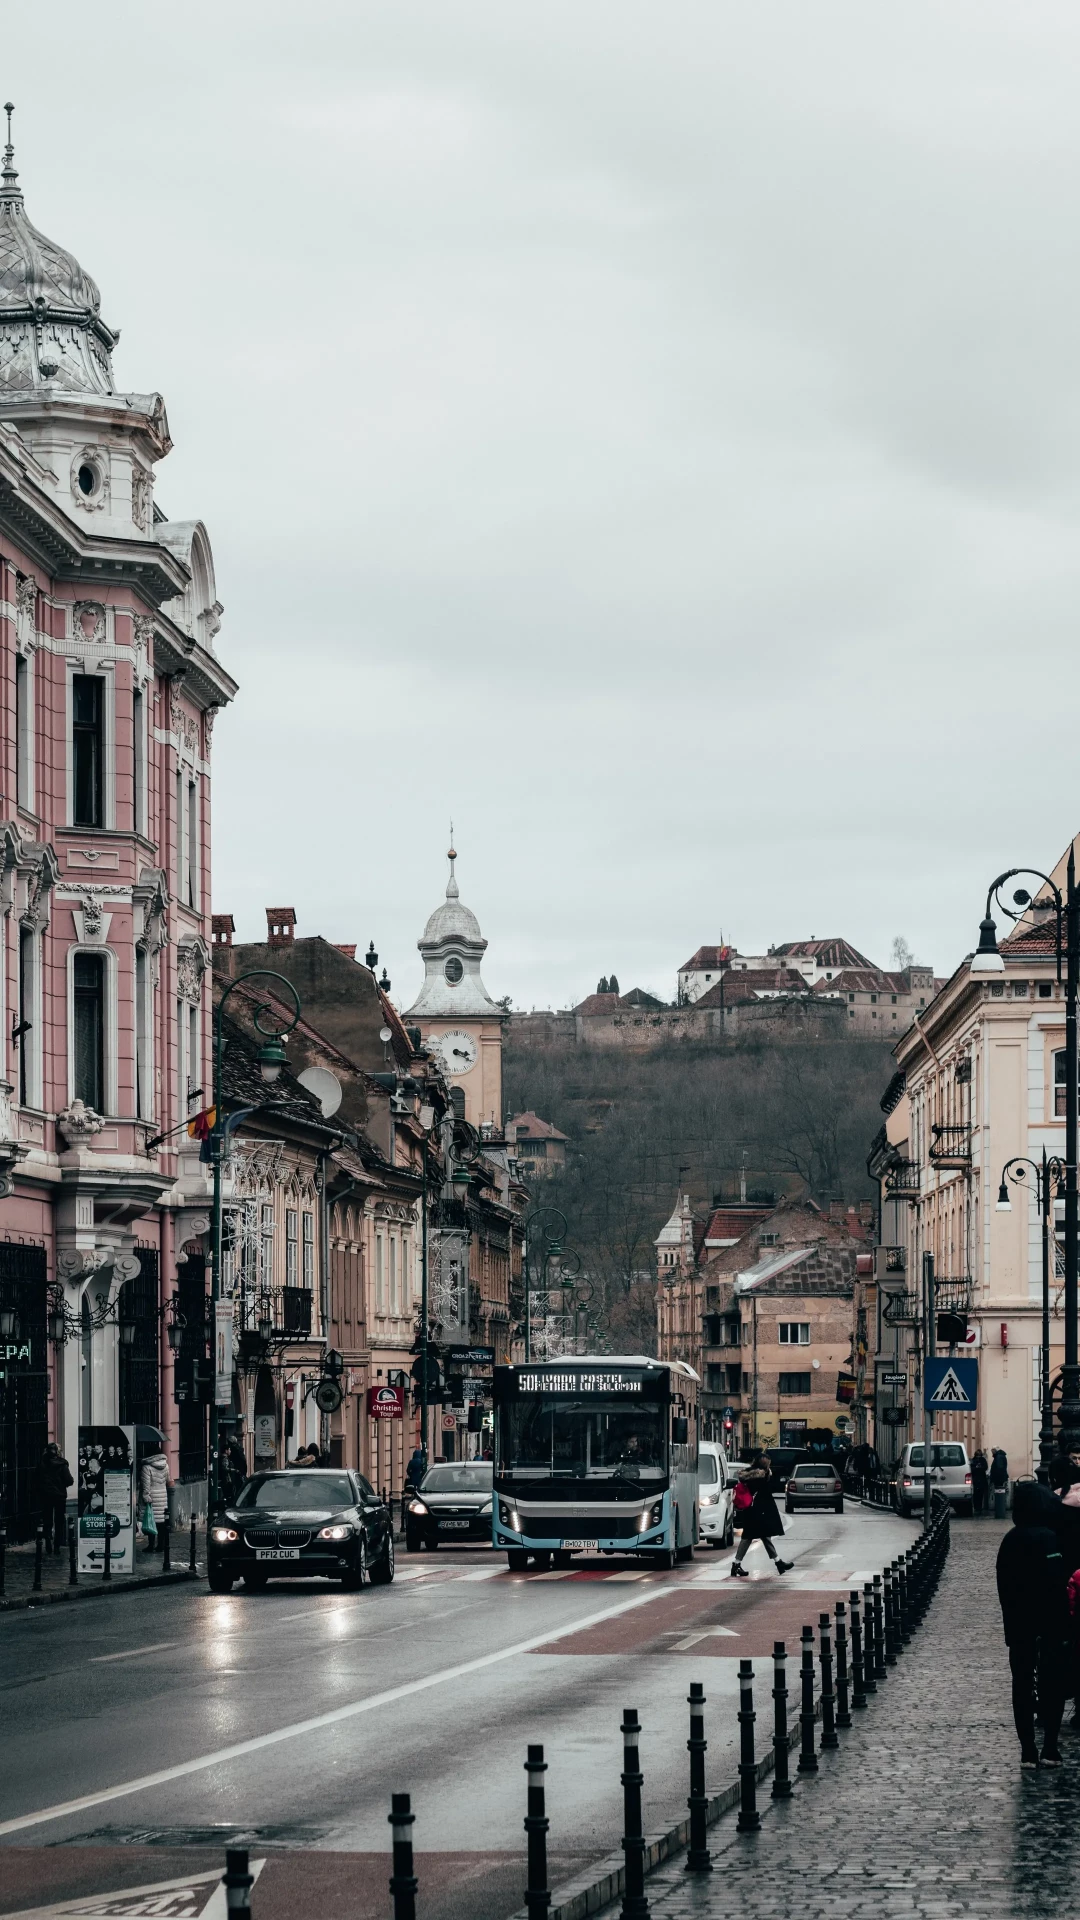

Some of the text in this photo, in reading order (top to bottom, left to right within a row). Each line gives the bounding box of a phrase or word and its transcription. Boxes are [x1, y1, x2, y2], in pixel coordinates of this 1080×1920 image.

[519, 1375, 534, 1391] 50
[580, 1383, 594, 1391] LUI
[598, 1383, 641, 1391] SOLOMON
